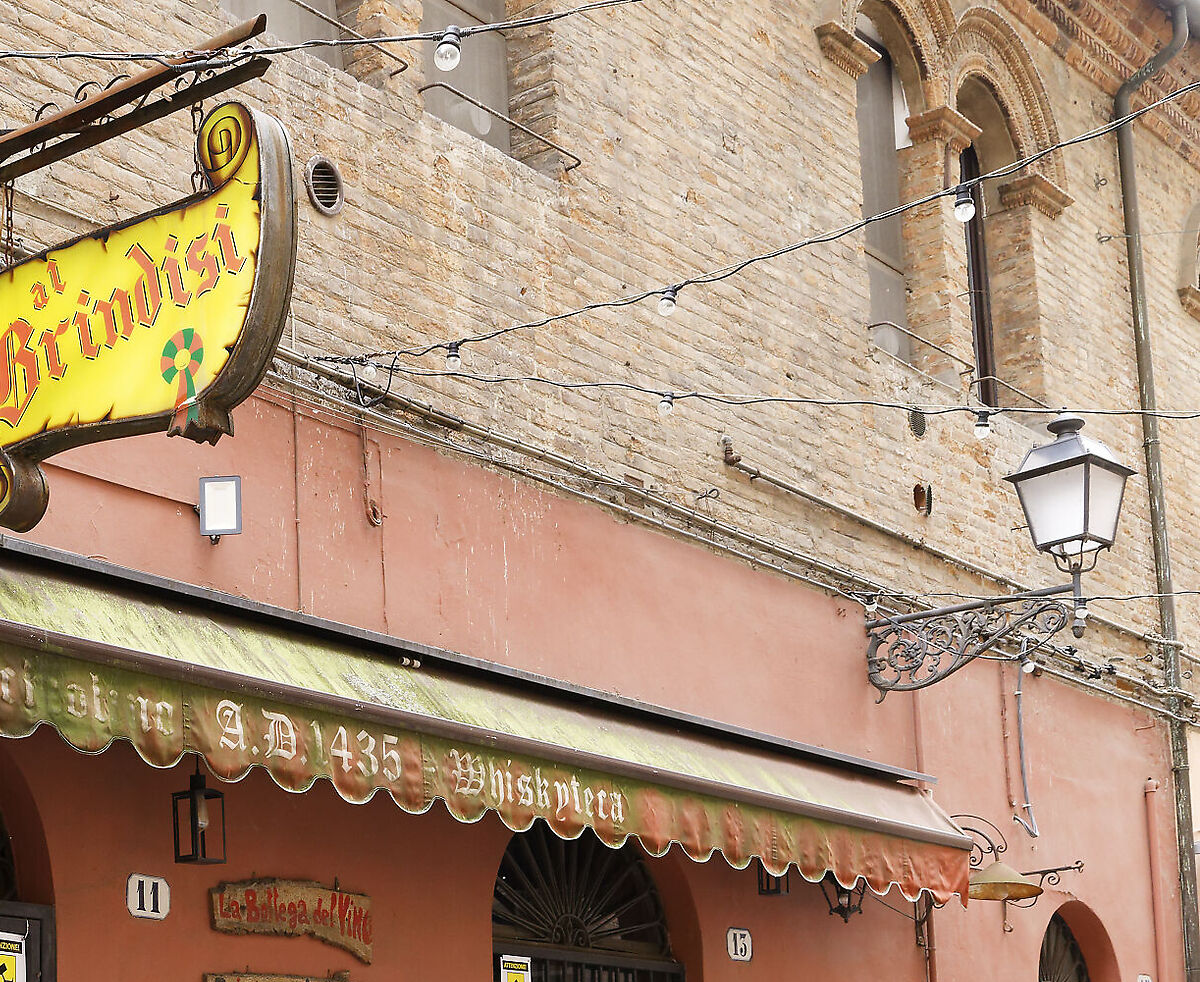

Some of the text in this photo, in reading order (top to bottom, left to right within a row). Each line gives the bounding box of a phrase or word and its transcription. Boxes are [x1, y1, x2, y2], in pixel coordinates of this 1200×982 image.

[30, 259, 67, 310] al
[449, 748, 625, 824] Whiskyteca
[137, 880, 160, 913] 11
[219, 892, 242, 921] La
[244, 887, 311, 929] Bottega
[312, 892, 337, 928] del
